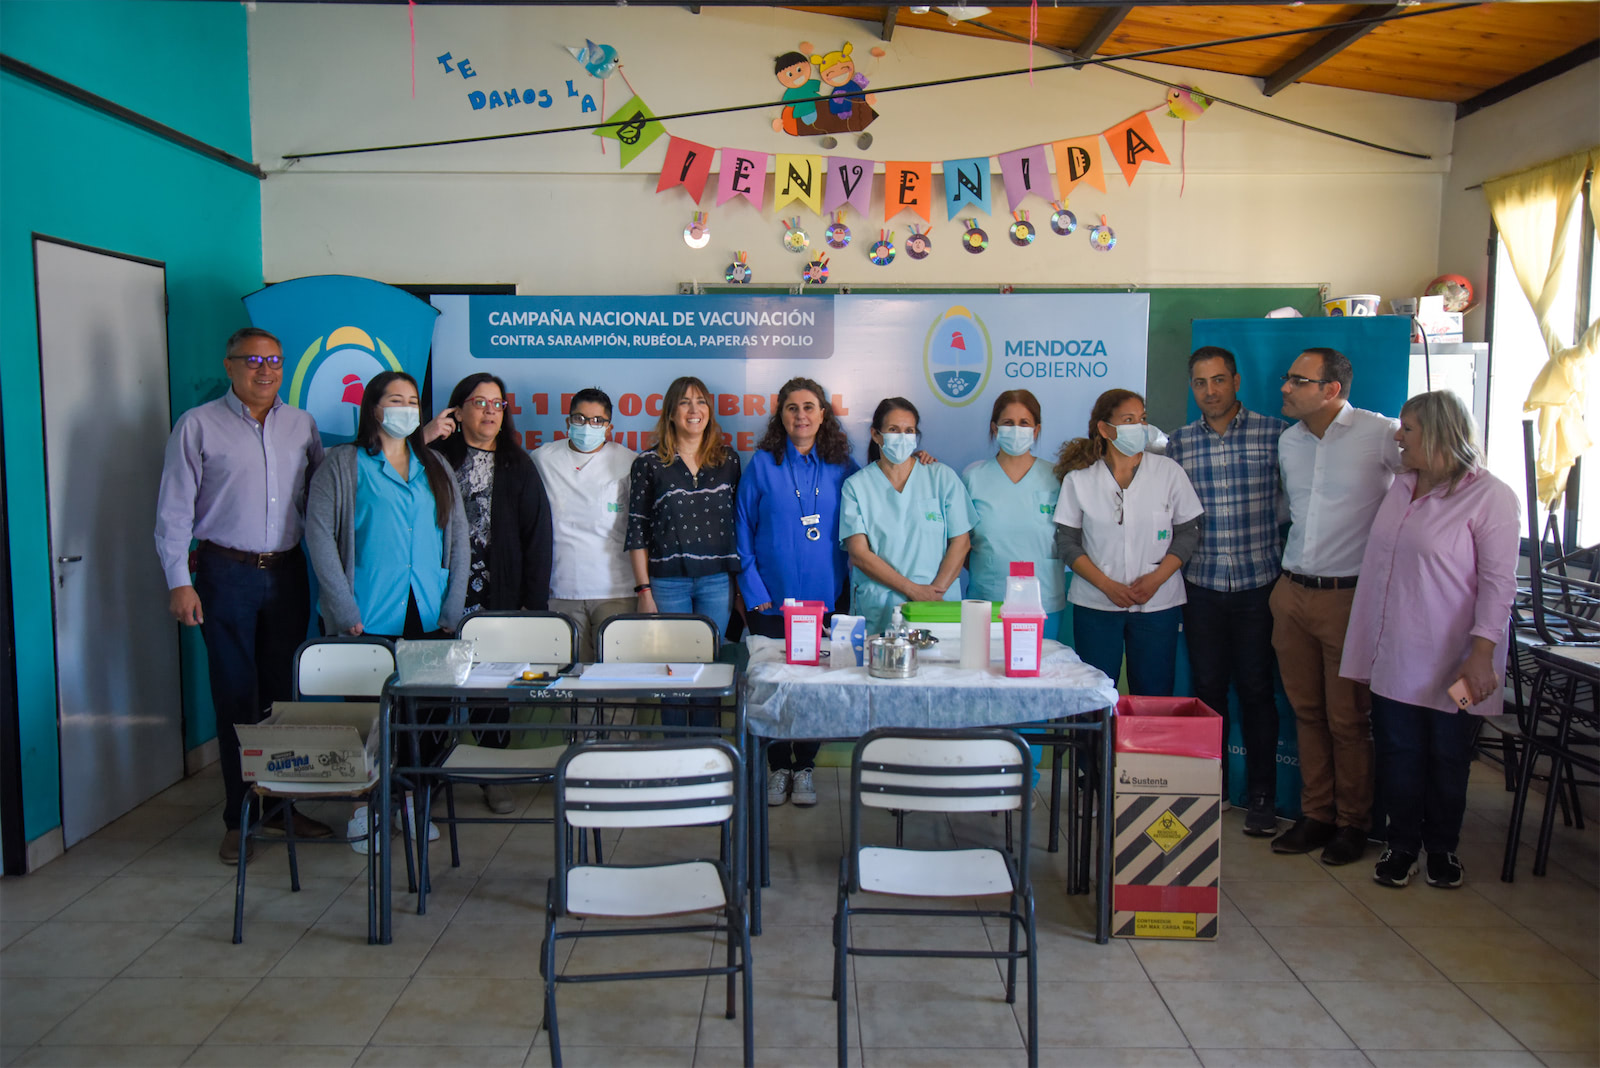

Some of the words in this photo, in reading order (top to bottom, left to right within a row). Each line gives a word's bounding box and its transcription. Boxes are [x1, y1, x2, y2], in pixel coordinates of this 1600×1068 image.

[437, 51, 477, 80] TE
[467, 88, 553, 111] DAMOS
[565, 79, 598, 113] LA
[488, 310, 575, 326] CAMPAÑA
[579, 311, 669, 326] NACIONAL
[673, 312, 694, 326] DE
[698, 309, 816, 326] VACUNACIÓN
[490, 335, 545, 347] CONTRA
[547, 333, 631, 348] SARAMPIÓN,
[633, 333, 697, 348] RUBÉOLA,
[699, 335, 758, 347] PAPERAS
[760, 335, 769, 347] Y
[772, 335, 814, 347] POLIO
[1005, 340, 1108, 357] MENDOZA
[1005, 361, 1108, 378] GOBIERNO
[532, 393, 549, 415] 1
[267, 755, 310, 773] FULBITO
[1131, 776, 1168, 785] Sustenta
